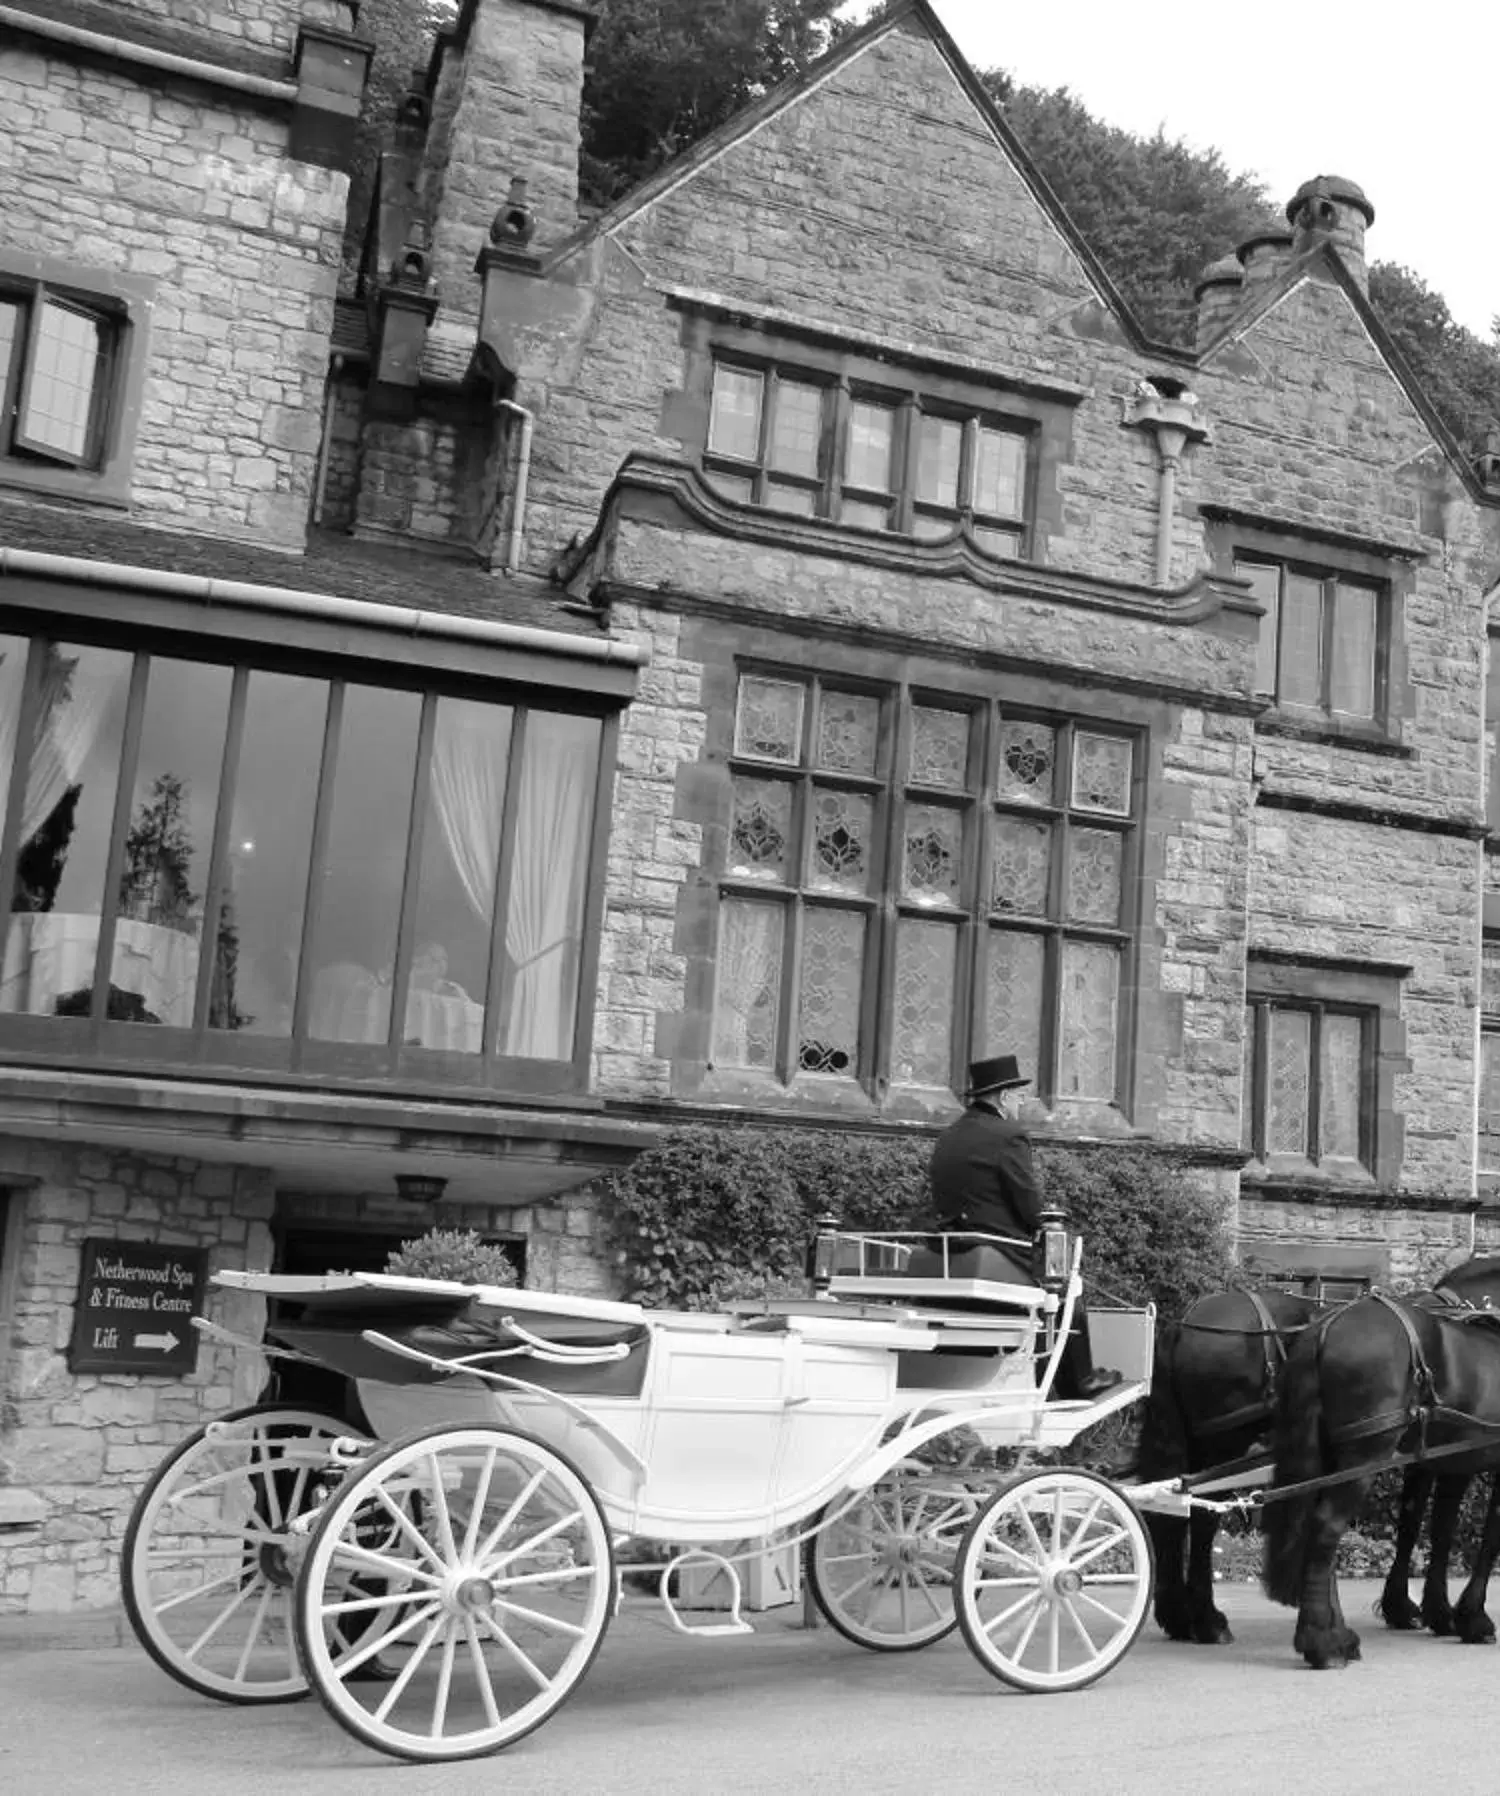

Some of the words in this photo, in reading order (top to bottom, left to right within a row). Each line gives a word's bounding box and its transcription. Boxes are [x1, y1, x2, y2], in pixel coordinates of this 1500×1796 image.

[94, 1257, 170, 1283] Netherwood
[172, 1264, 194, 1290] Spa
[90, 1287, 103, 1307] &
[105, 1287, 149, 1309] Fitness
[153, 1290, 193, 1313] Centre
[92, 1327, 119, 1349] Lift
